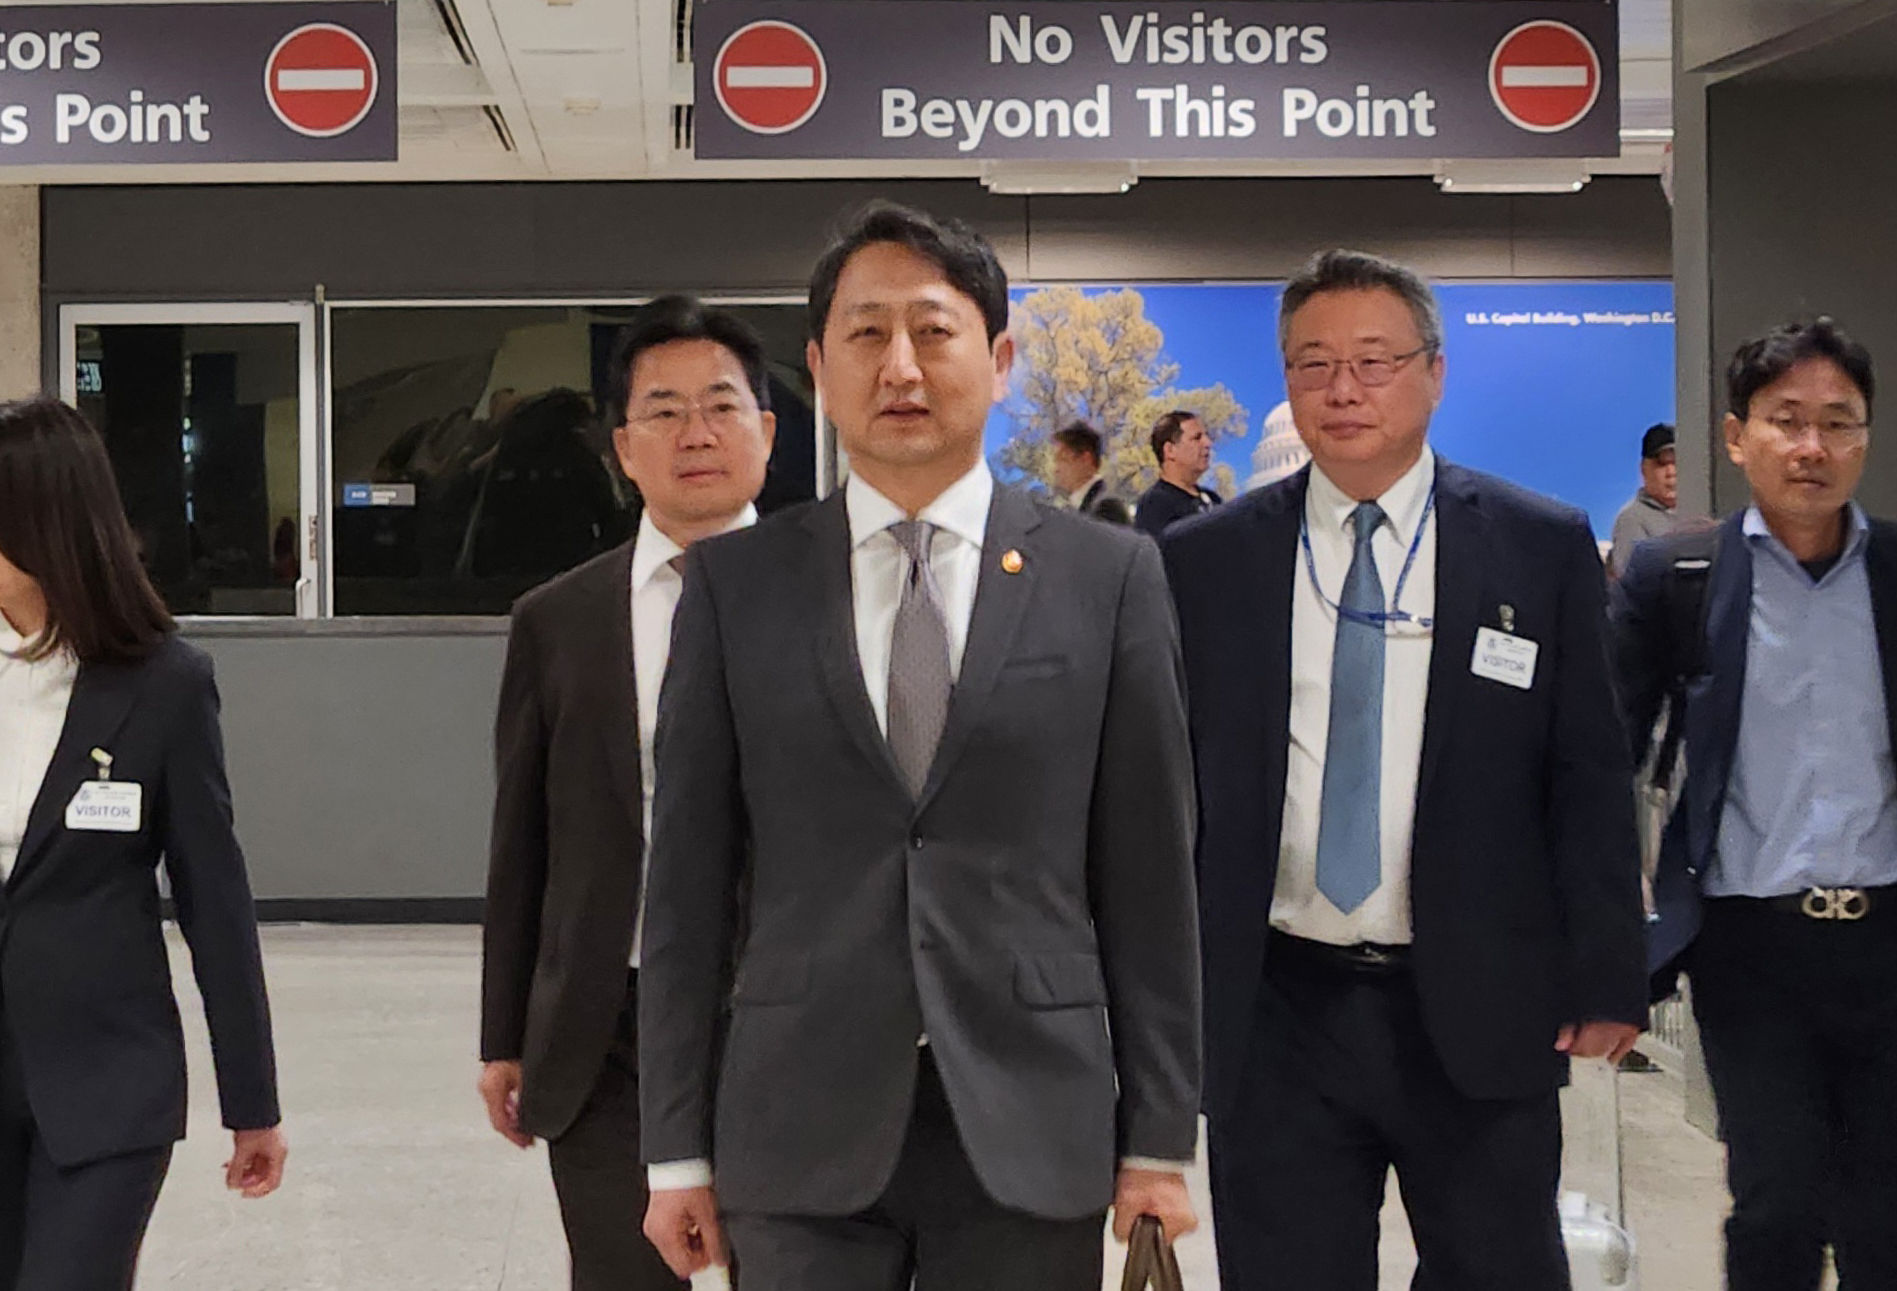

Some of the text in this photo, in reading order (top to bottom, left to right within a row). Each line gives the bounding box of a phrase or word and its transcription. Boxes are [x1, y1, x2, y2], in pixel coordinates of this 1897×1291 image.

[0, 31, 101, 70] ors
[990, 12, 1327, 64] No Visitors
[55, 89, 210, 144] Point
[881, 84, 1437, 152] Beyond This Point
[1465, 312, 1490, 325] U.S.
[1490, 312, 1531, 326] Capitol
[1582, 312, 1650, 327] Washington
[1482, 652, 1528, 674] VISITOR
[75, 804, 132, 818] VISITOR
